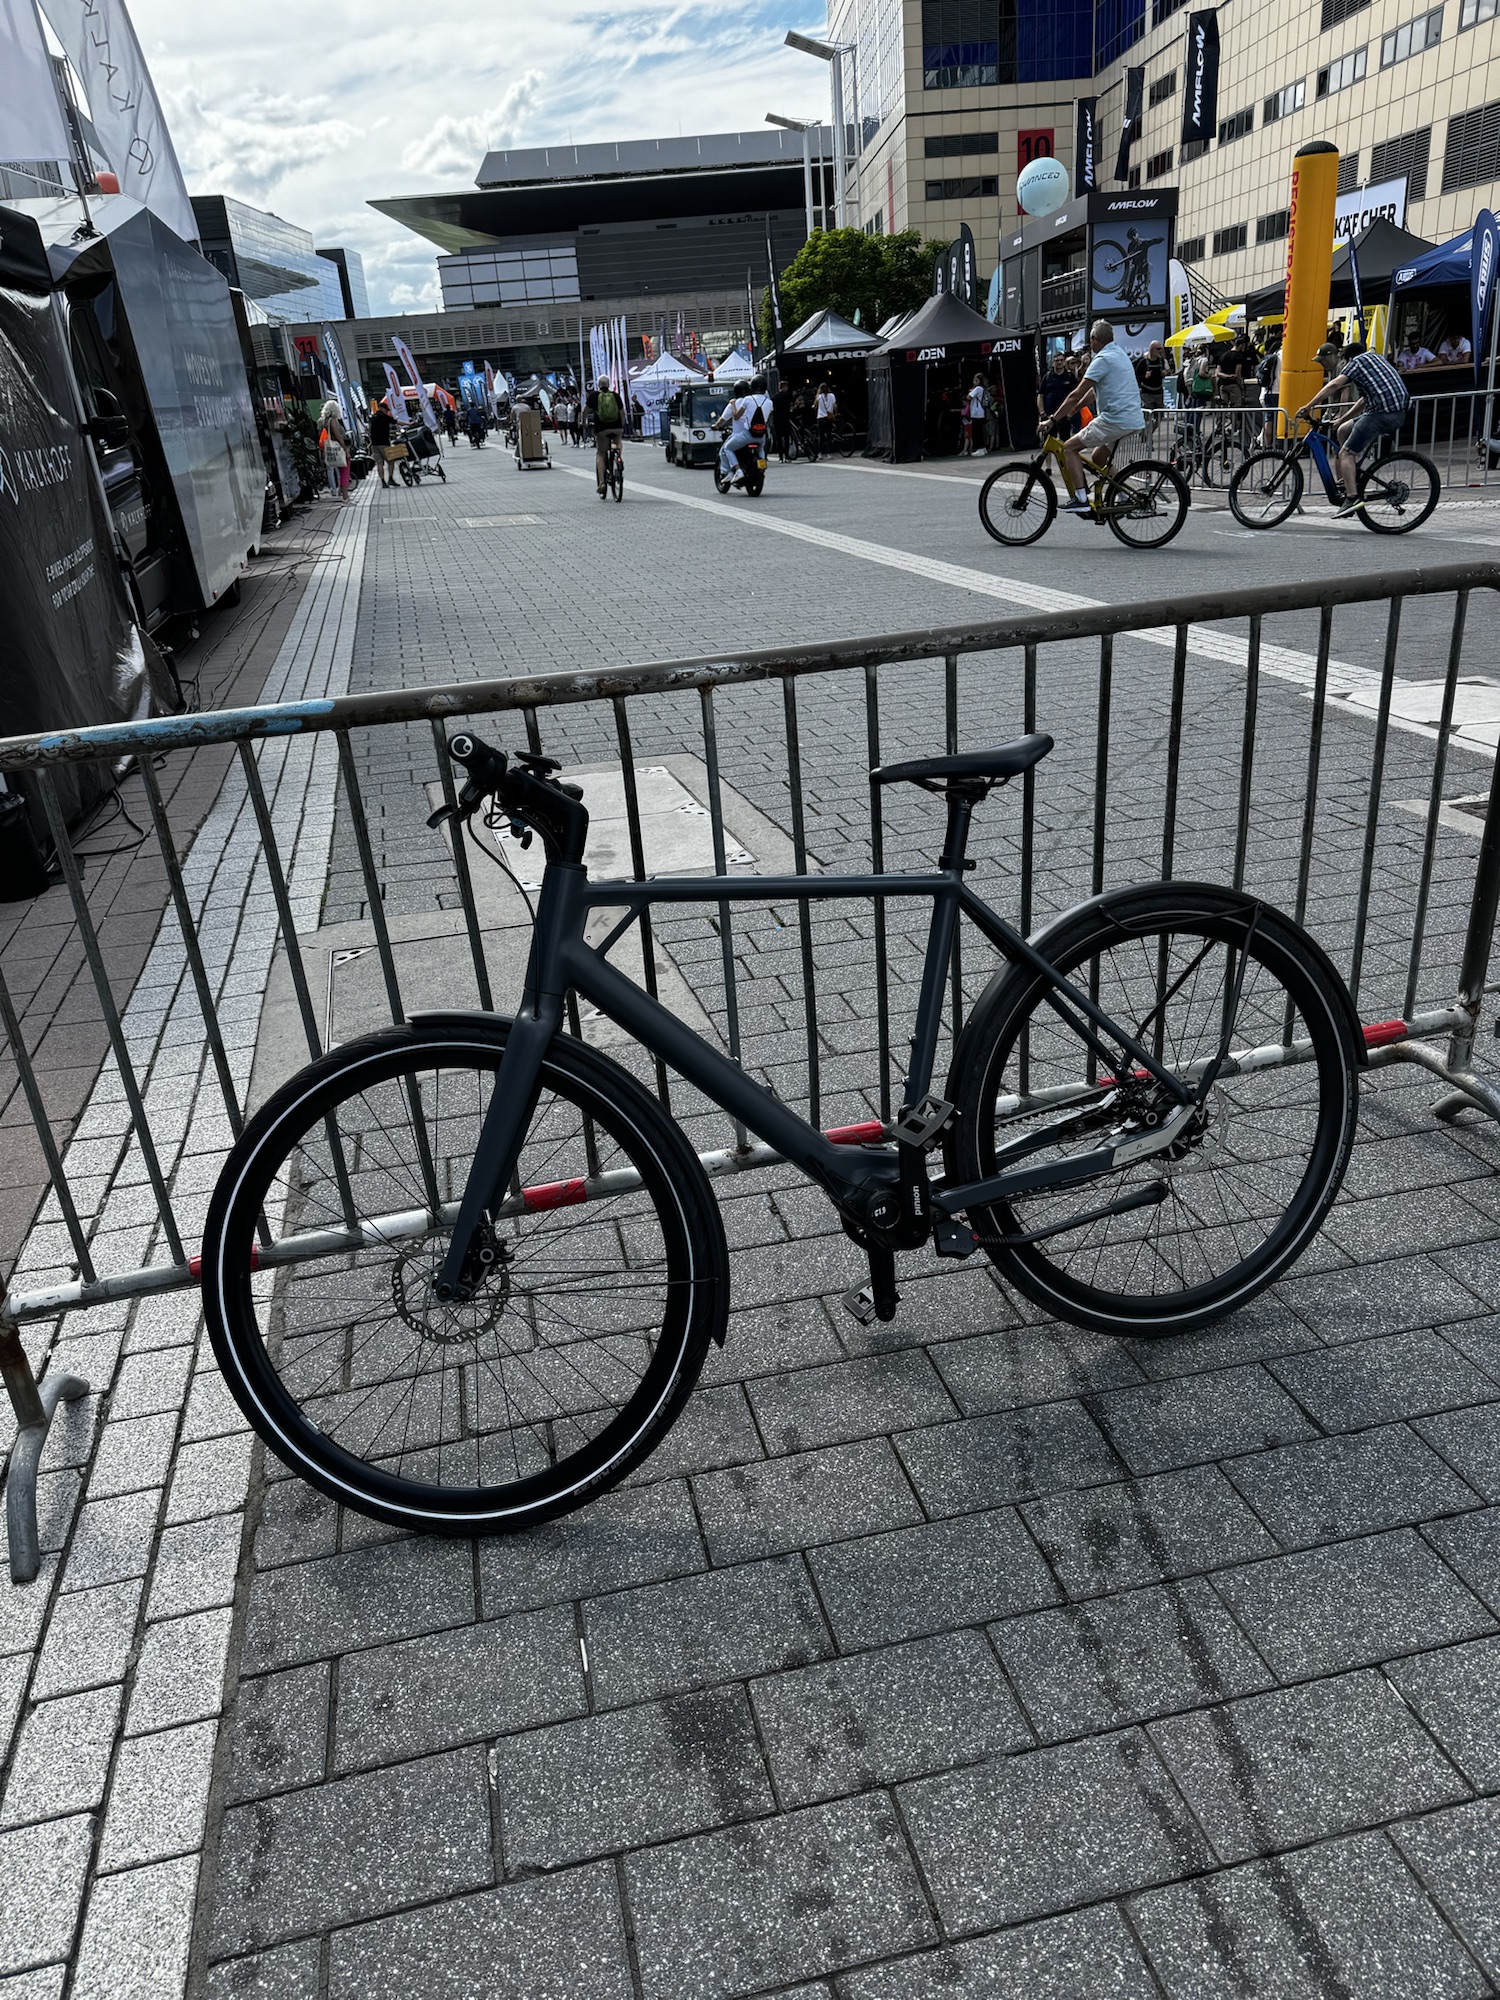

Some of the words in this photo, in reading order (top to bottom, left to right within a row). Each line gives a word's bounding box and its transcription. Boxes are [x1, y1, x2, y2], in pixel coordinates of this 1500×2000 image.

[1192, 25, 1205, 127] AMFLOW
[1021, 136, 1050, 164] 10
[1107, 199, 1158, 210] AMFLOW
[1479, 240, 1492, 302] ABUS
[300, 340, 313, 354] 11
[807, 350, 867, 362] HARO
[917, 347, 945, 361] ADEN
[992, 339, 1021, 353] ADEN
[14, 445, 73, 491] KALKHOFF
[913, 1185, 923, 1215] pinion
[657, 1371, 682, 1417] SCHWALBE
[610, 1446, 633, 1470] SPICER
[591, 1468, 610, 1486] PLUS
